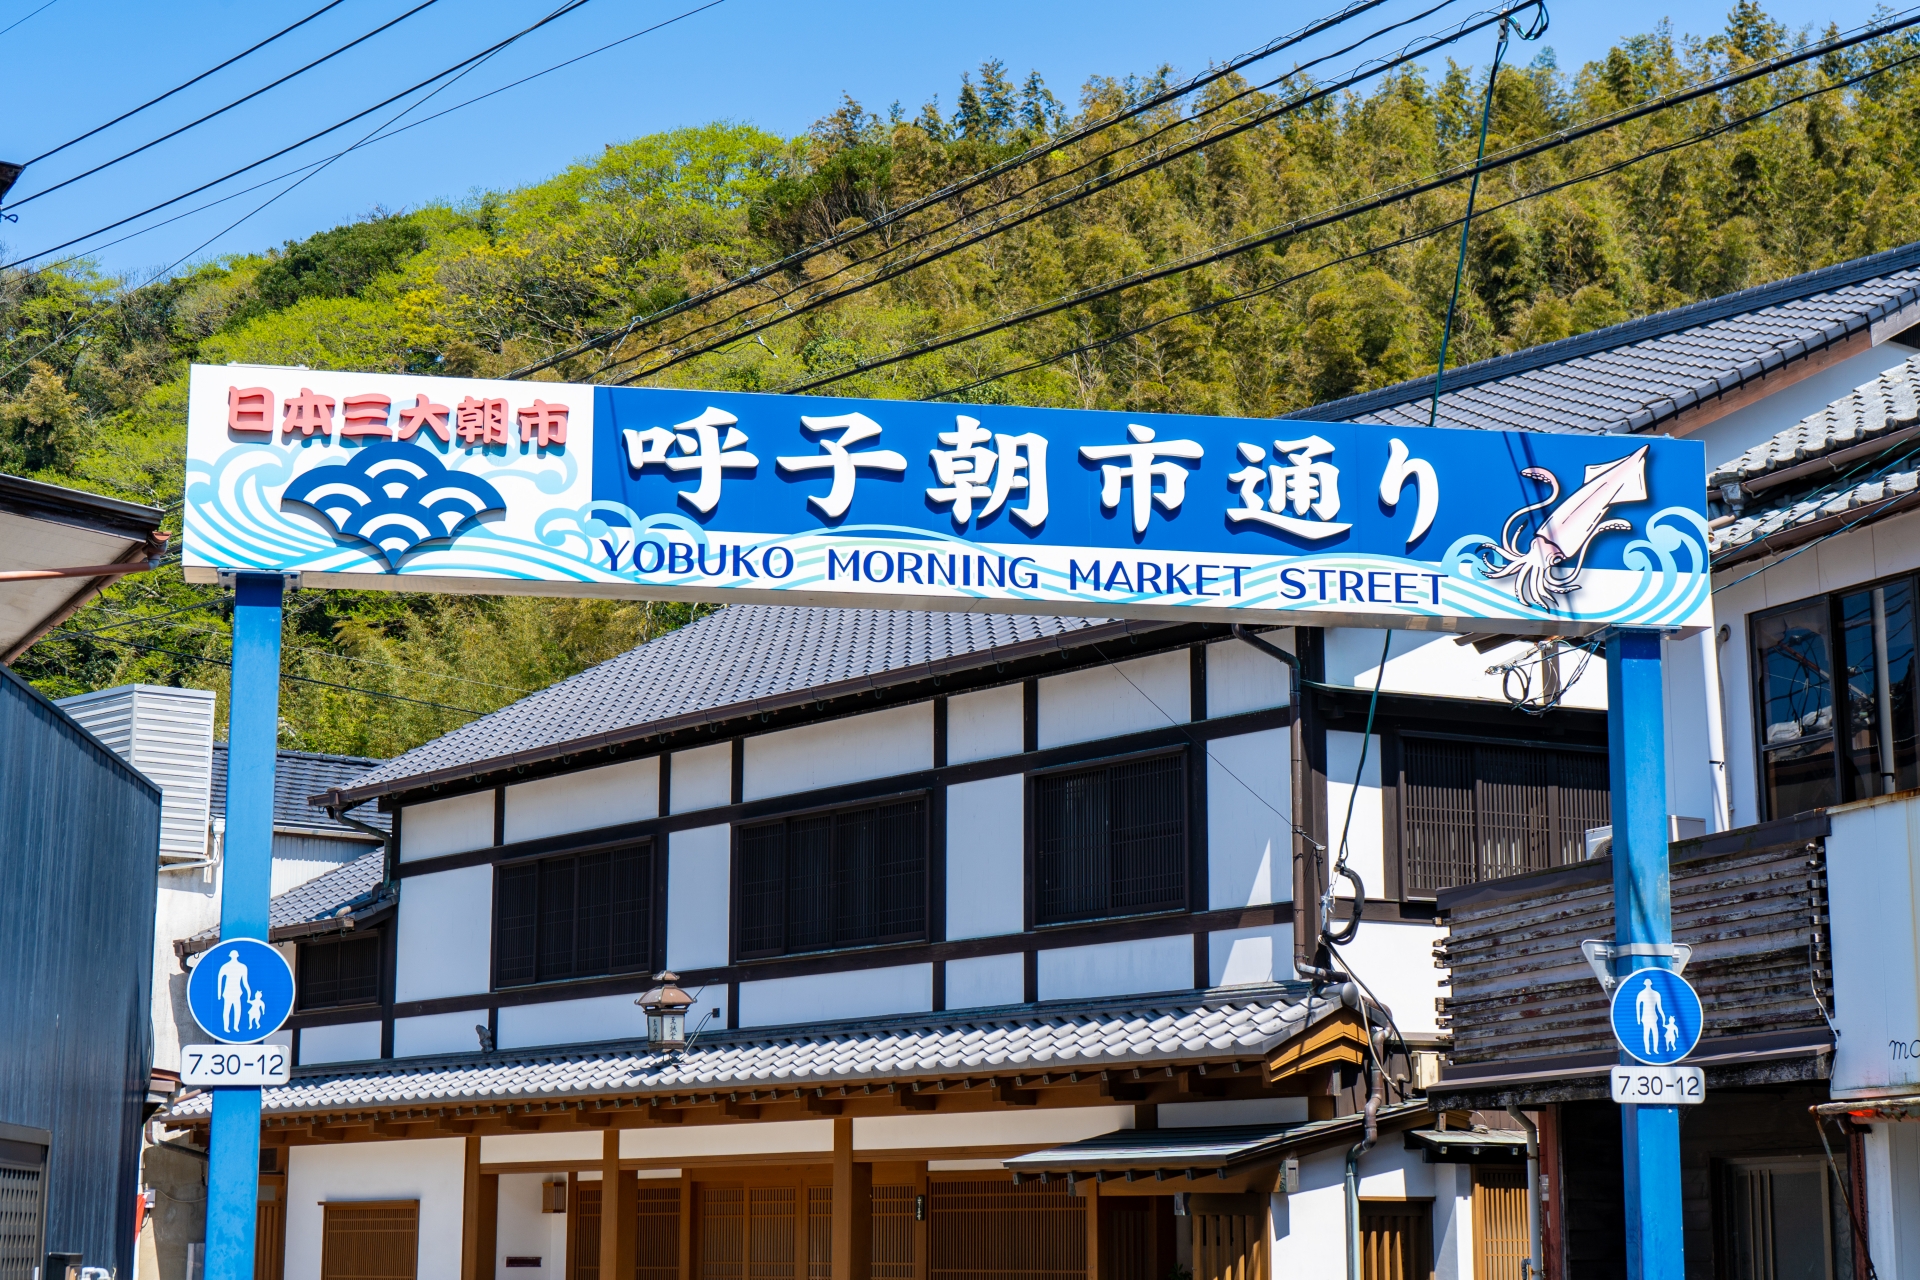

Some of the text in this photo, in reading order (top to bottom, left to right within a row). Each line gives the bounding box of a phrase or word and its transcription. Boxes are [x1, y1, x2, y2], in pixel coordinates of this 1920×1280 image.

[227, 385, 570, 448] 日本三大朝市
[621, 406, 1440, 544] 呼子朝市通り
[599, 538, 1449, 606] YOBUKO MORNING MARKET STREET
[188, 1053, 284, 1076] 7.30-12
[1618, 1075, 1700, 1097] 7.30-12
